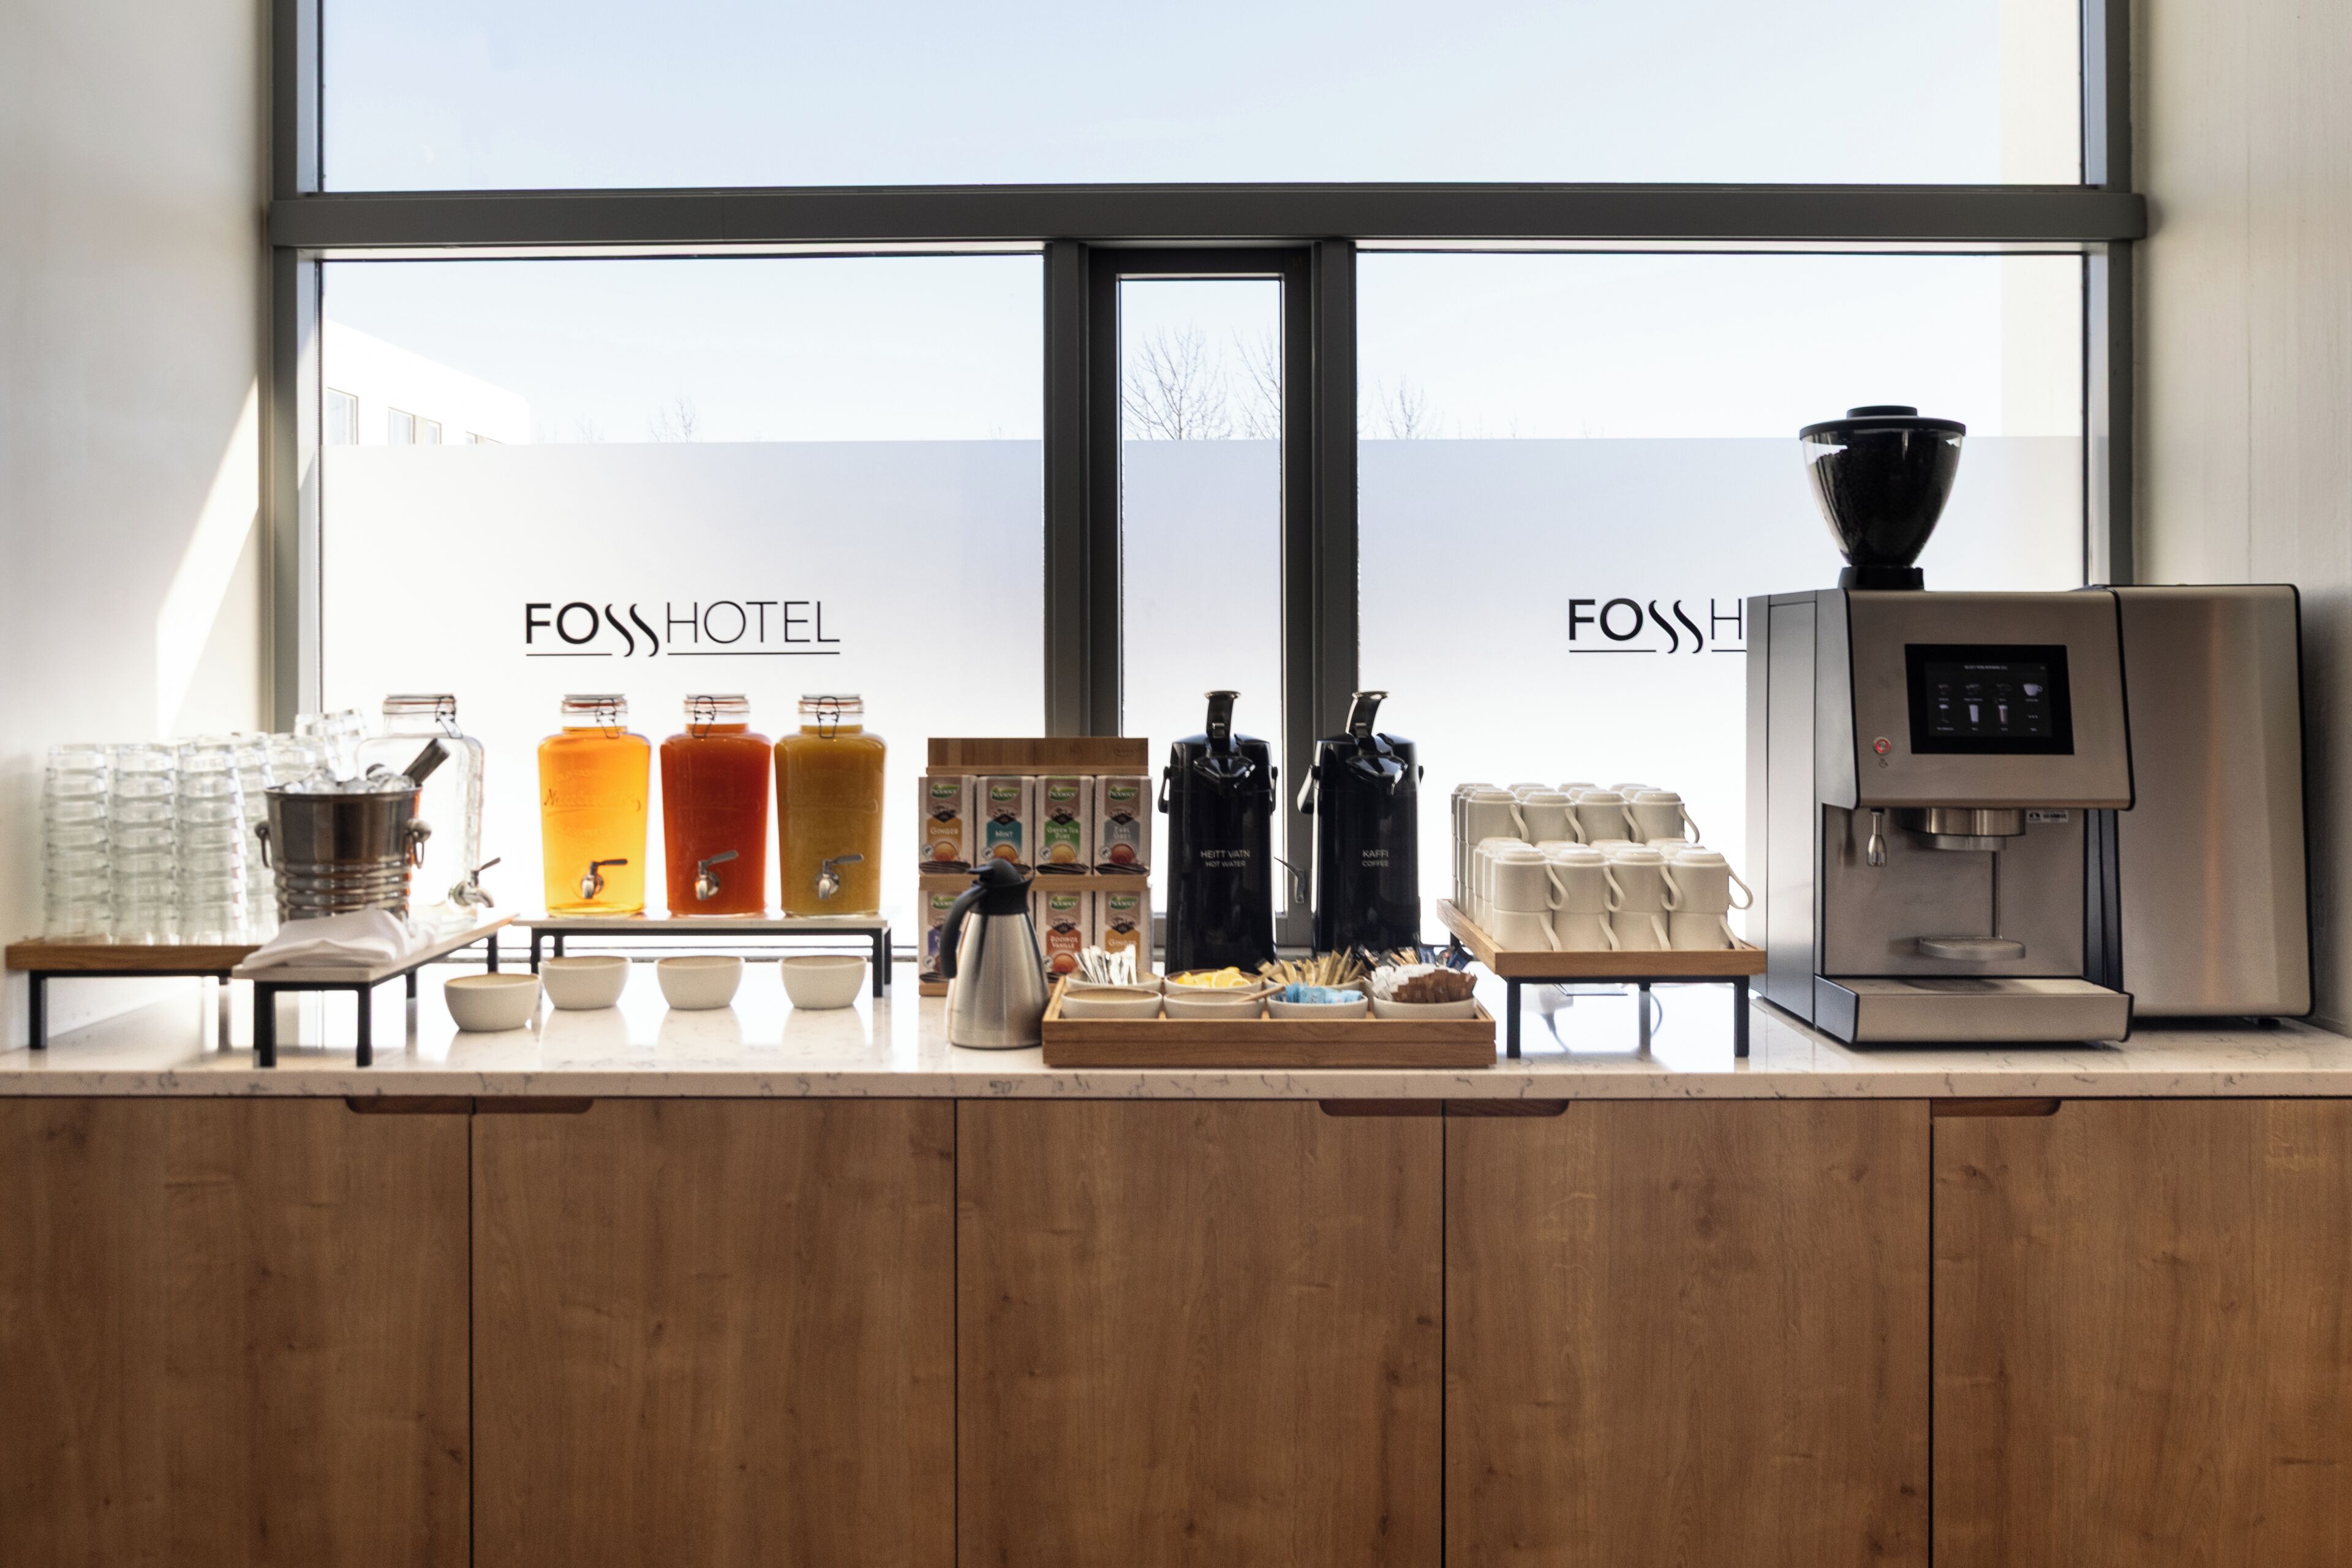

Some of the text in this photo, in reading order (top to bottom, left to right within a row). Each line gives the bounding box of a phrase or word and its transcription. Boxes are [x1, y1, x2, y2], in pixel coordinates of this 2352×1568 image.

[526, 601, 840, 657] FOSSHOTEL
[1569, 598, 1743, 654] FOSSH
[1200, 849, 1250, 858] HEITT VATN
[1362, 849, 1389, 858] KAFFI
